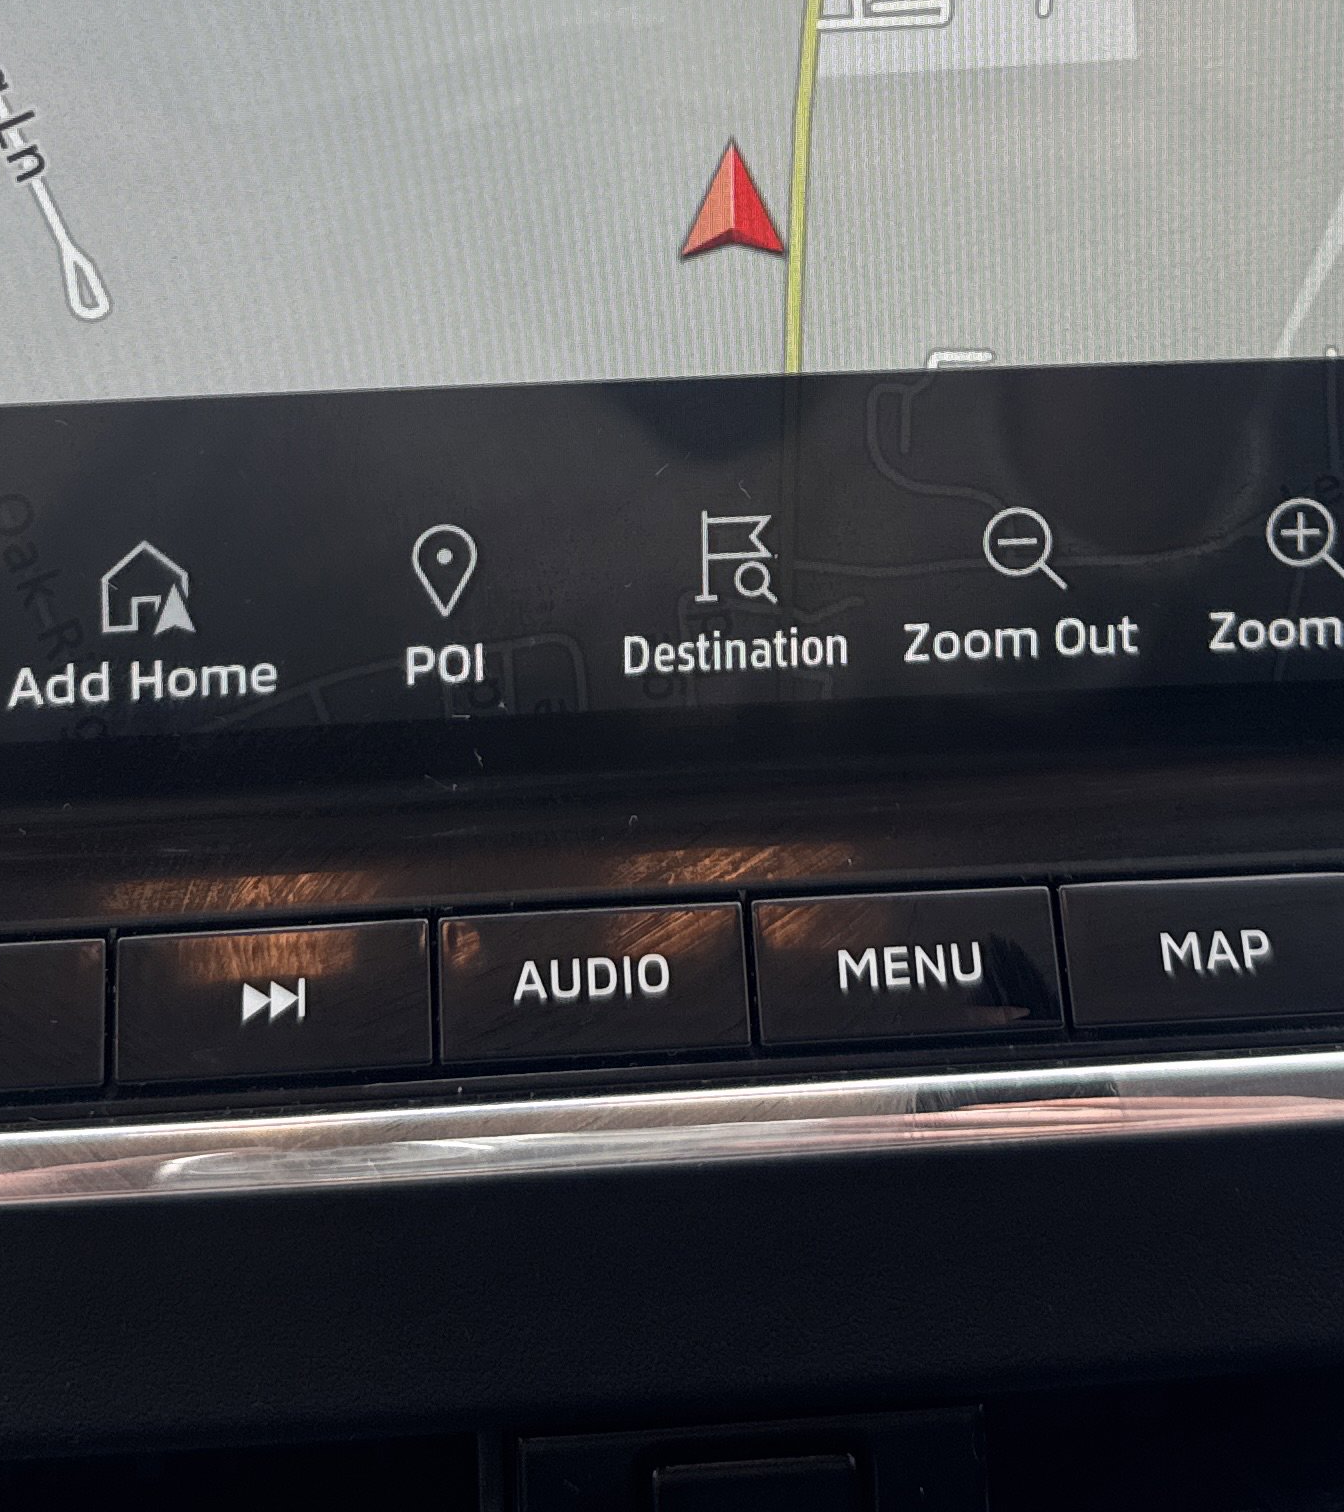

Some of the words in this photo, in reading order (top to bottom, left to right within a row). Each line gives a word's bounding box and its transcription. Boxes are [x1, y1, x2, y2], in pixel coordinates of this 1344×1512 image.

[622, 626, 850, 676] Destination
[903, 622, 1039, 663] Zoom
[1054, 615, 1140, 657] Out
[1208, 610, 1344, 652] Zoom
[7, 660, 111, 710] Add
[130, 655, 280, 703] Home
[405, 642, 486, 688] POI
[837, 940, 984, 994] MENU
[1159, 928, 1271, 974] MAP
[513, 952, 671, 1004] AUDIO
